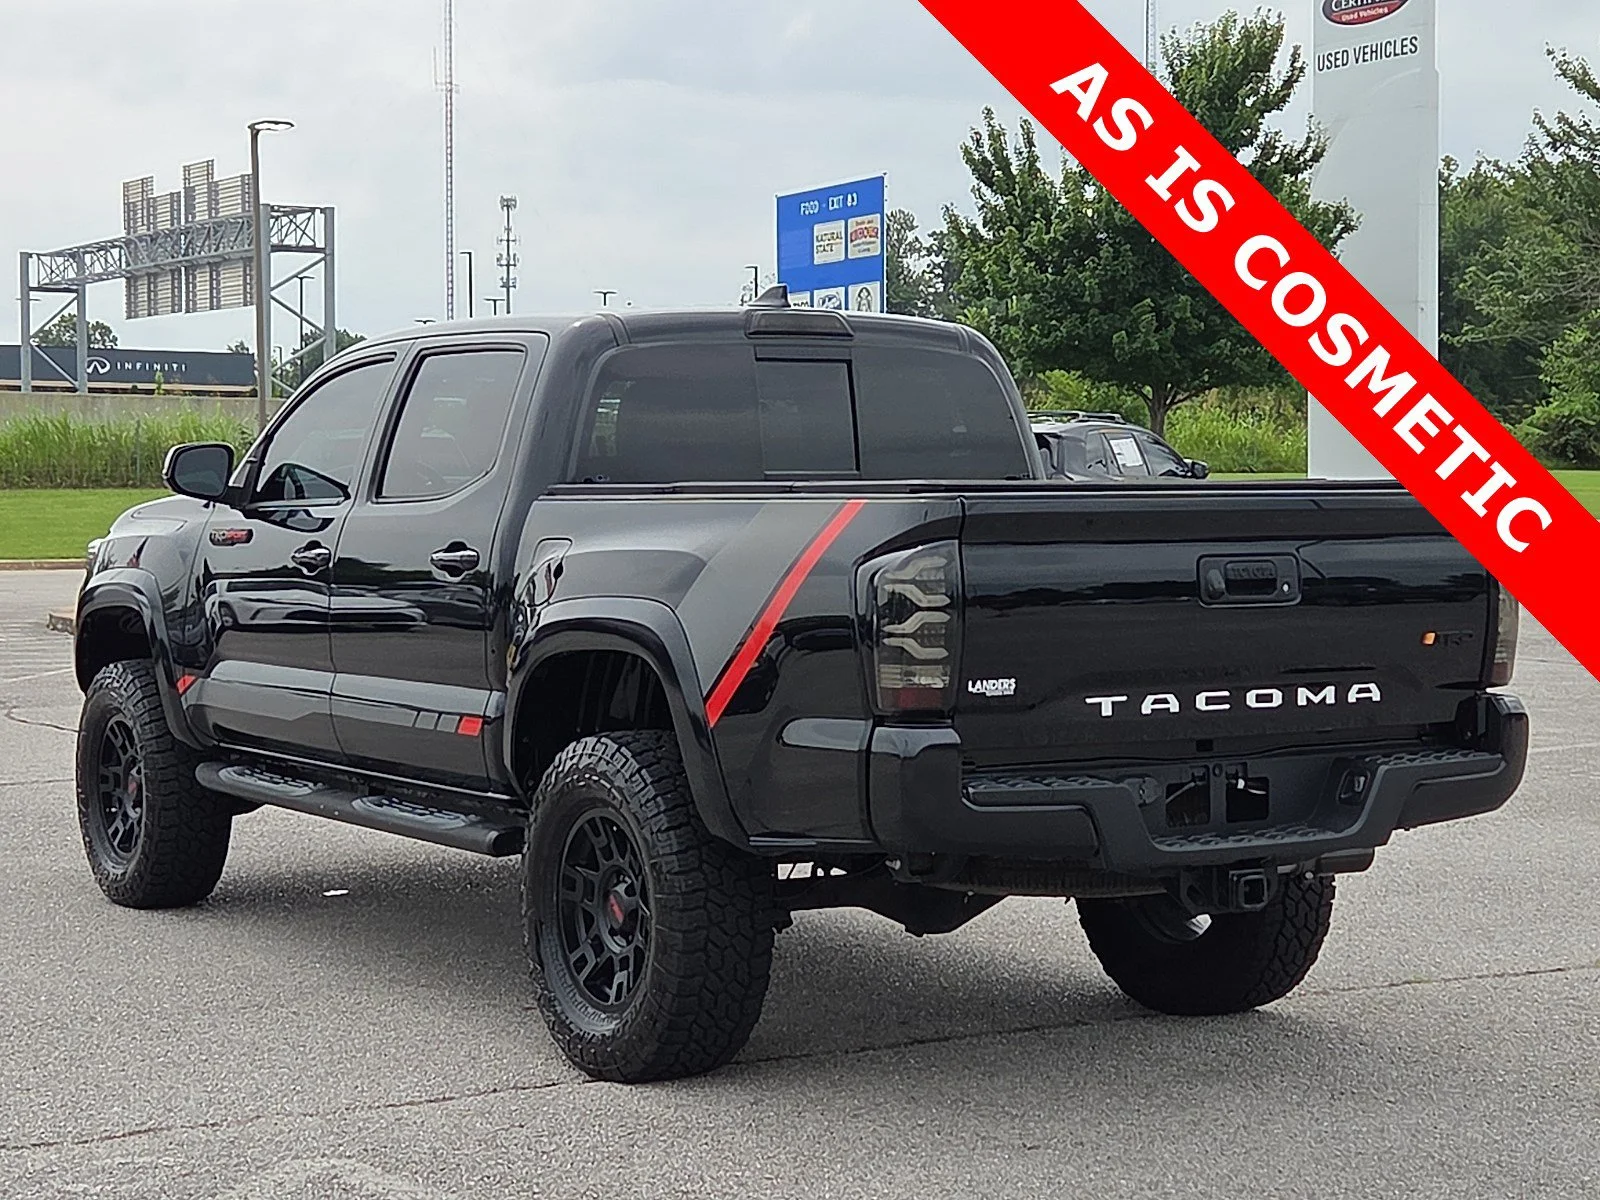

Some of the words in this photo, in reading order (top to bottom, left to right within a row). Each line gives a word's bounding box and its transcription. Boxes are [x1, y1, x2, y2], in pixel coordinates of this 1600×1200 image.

[1317, 49, 1350, 72] USED
[1353, 36, 1418, 64] VEHICLES
[800, 200, 819, 215] FOOD
[828, 195, 844, 211] EXIT
[815, 231, 843, 243] NATURAL
[116, 362, 187, 372] INFINITI
[968, 678, 1016, 692] LANDERS
[1085, 682, 1382, 717] TACOMA
